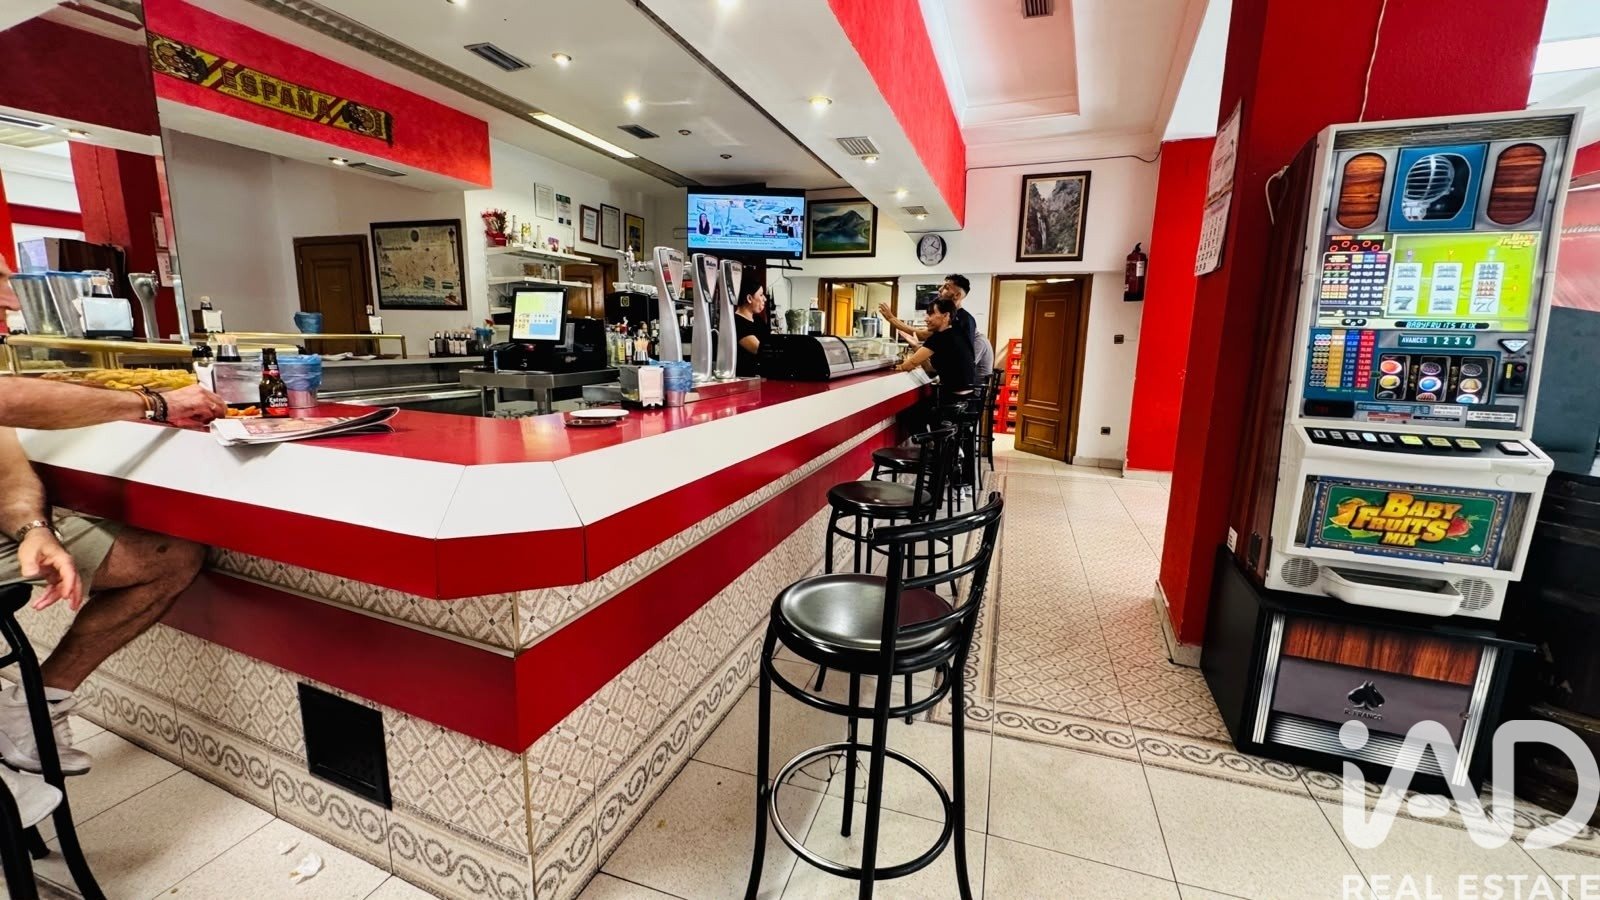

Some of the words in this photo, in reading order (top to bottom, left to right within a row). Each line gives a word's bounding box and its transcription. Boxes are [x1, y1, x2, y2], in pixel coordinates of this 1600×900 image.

[221, 64, 332, 119] ESPAÑA
[1381, 491, 1462, 520] BABY
[1351, 507, 1450, 542] FRUITS
[1381, 532, 1420, 547] MIX
[1353, 709, 1382, 720] FRANCO
